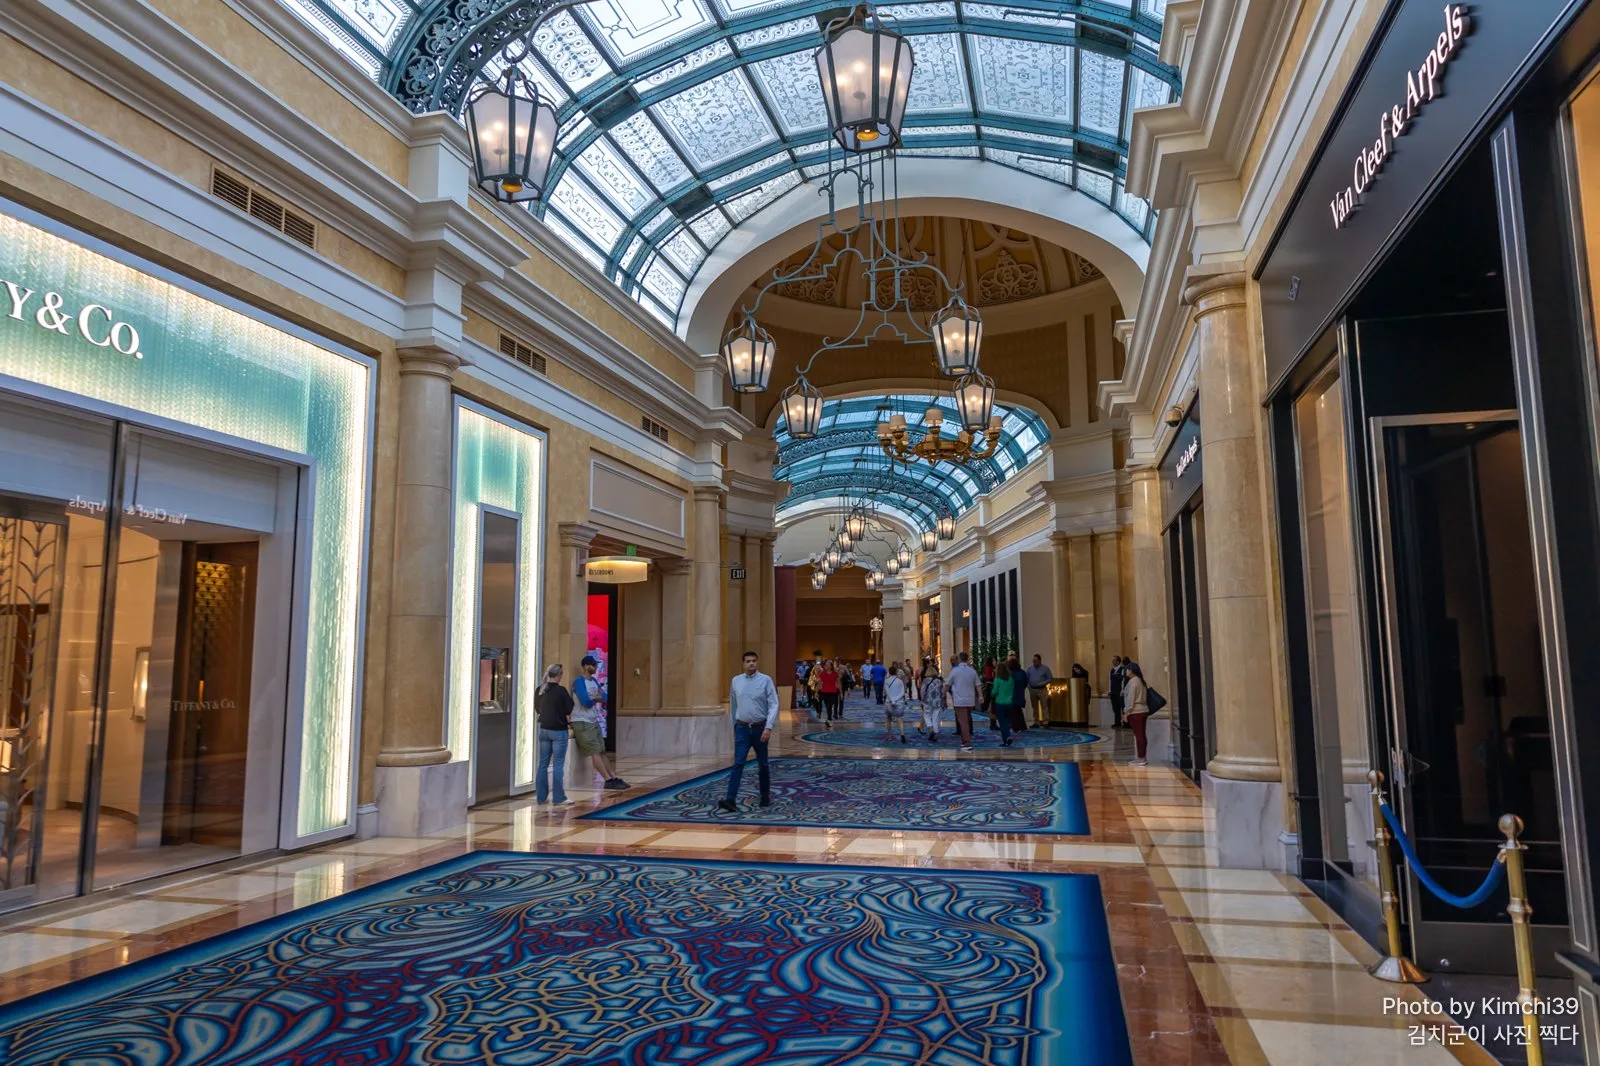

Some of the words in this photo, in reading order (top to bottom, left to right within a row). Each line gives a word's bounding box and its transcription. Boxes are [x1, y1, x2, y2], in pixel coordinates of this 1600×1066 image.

[1330, 186, 1353, 230] Van
[1353, 112, 1388, 195] Cleef
[1391, 104, 1404, 139] &
[1406, 4, 1463, 119] Arpels
[732, 569, 745, 579] EXIT
